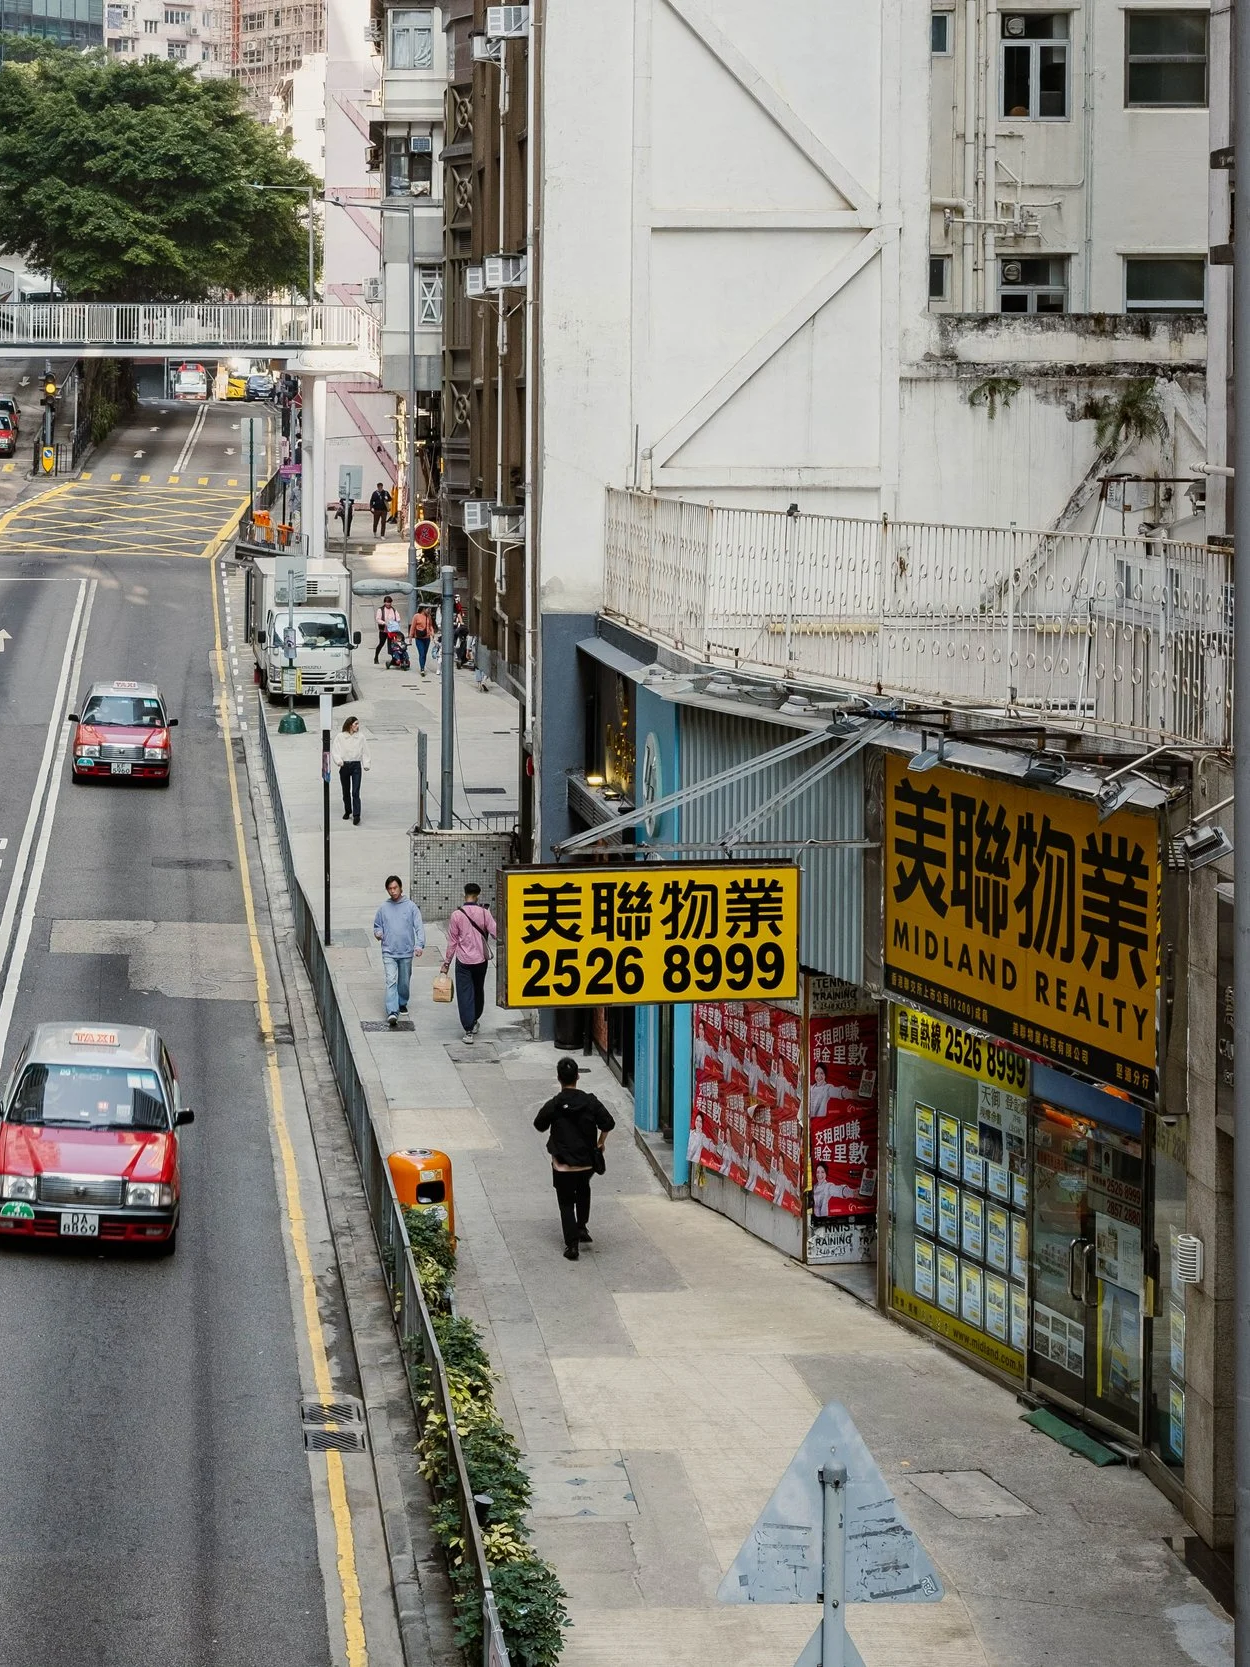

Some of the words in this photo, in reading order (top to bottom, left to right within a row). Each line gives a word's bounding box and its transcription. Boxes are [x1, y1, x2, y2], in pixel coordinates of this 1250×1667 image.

[892, 778, 1150, 990] 美聯物業
[521, 878, 784, 944] 美聯物業
[521, 945, 645, 998] 2526
[662, 941, 785, 994] 8999
[893, 918, 1018, 992] MIDLAND
[1035, 970, 1149, 1042] REALTY
[75, 1033, 115, 1043] TAXI
[814, 1021, 860, 1047] 交租即賺
[813, 1042, 868, 1066] 現金里數
[945, 1025, 982, 1073] 2526
[986, 1042, 1026, 1089] 8999
[815, 1119, 861, 1146] 交租即賺
[814, 1141, 869, 1165] 現金里數
[63, 1223, 96, 1235] 8869
[71, 1213, 88, 1224] DA
[816, 1235, 852, 1246] RAINING
